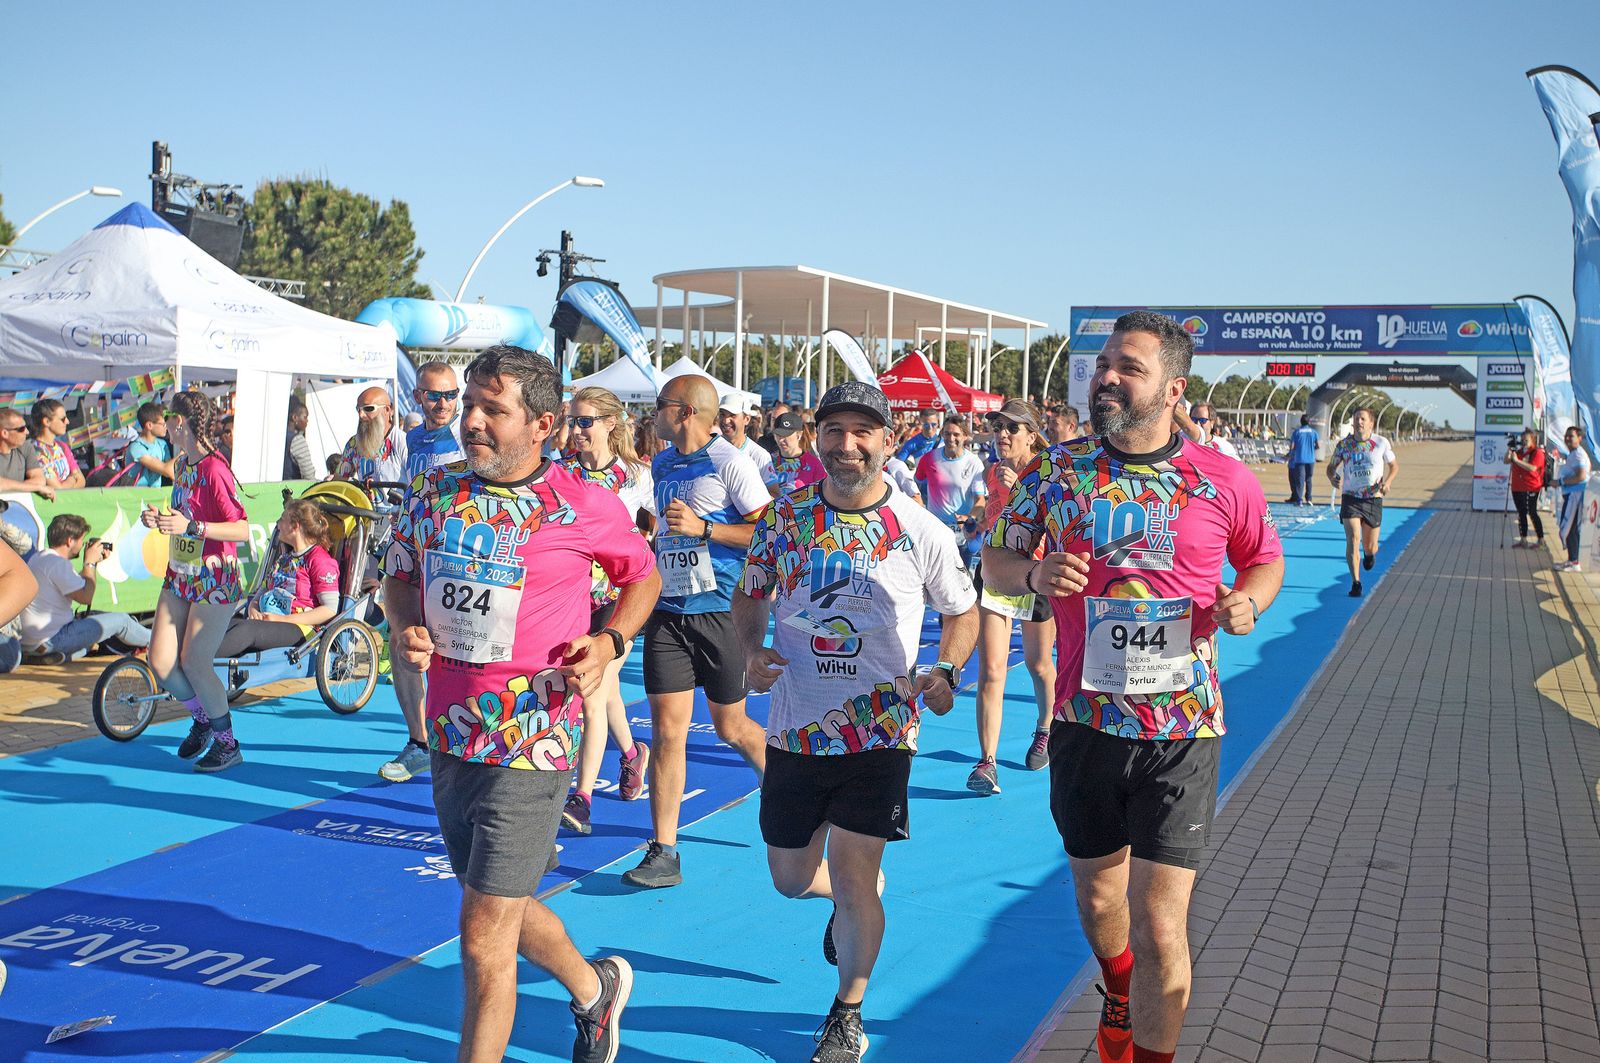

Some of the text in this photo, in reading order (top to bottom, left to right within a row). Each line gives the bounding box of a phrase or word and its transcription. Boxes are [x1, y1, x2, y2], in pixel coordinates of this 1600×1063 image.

[1223, 311, 1326, 324] CAMPEONATO
[1221, 324, 1363, 341] de ESPAÑA 10 km
[1376, 314, 1448, 348] 10 HUELVA
[1486, 323, 1527, 335] WiHu
[1289, 341, 1324, 349] Absoluto
[1333, 341, 1362, 349] Master
[1091, 498, 1179, 560] 10 HU
[1147, 518, 1178, 535] EL
[444, 517, 530, 560] 10 HU
[683, 538, 699, 546] 2023
[1146, 533, 1175, 551] VA
[494, 542, 524, 562] EL
[662, 551, 699, 569] 1790
[485, 568, 515, 584] 2023
[809, 548, 879, 602] 10 HU
[852, 568, 876, 583] EL
[852, 581, 873, 597] VA
[441, 582, 491, 616] 824
[1108, 606, 1131, 614] HUELVA
[1156, 604, 1183, 617] 2023
[438, 623, 488, 639] DANTAS ESPADAS
[1111, 625, 1167, 651] 944
[450, 640, 475, 652] Syrluz
[816, 659, 857, 675] WiHu
[1126, 656, 1151, 664] ALEXIS
[1147, 663, 1172, 671] MUÑOZ
[1129, 676, 1157, 686] Syrluz
[320, 831, 437, 851] Ayuntamiento
[53, 913, 160, 934] original
[0, 925, 323, 993] Huelva
